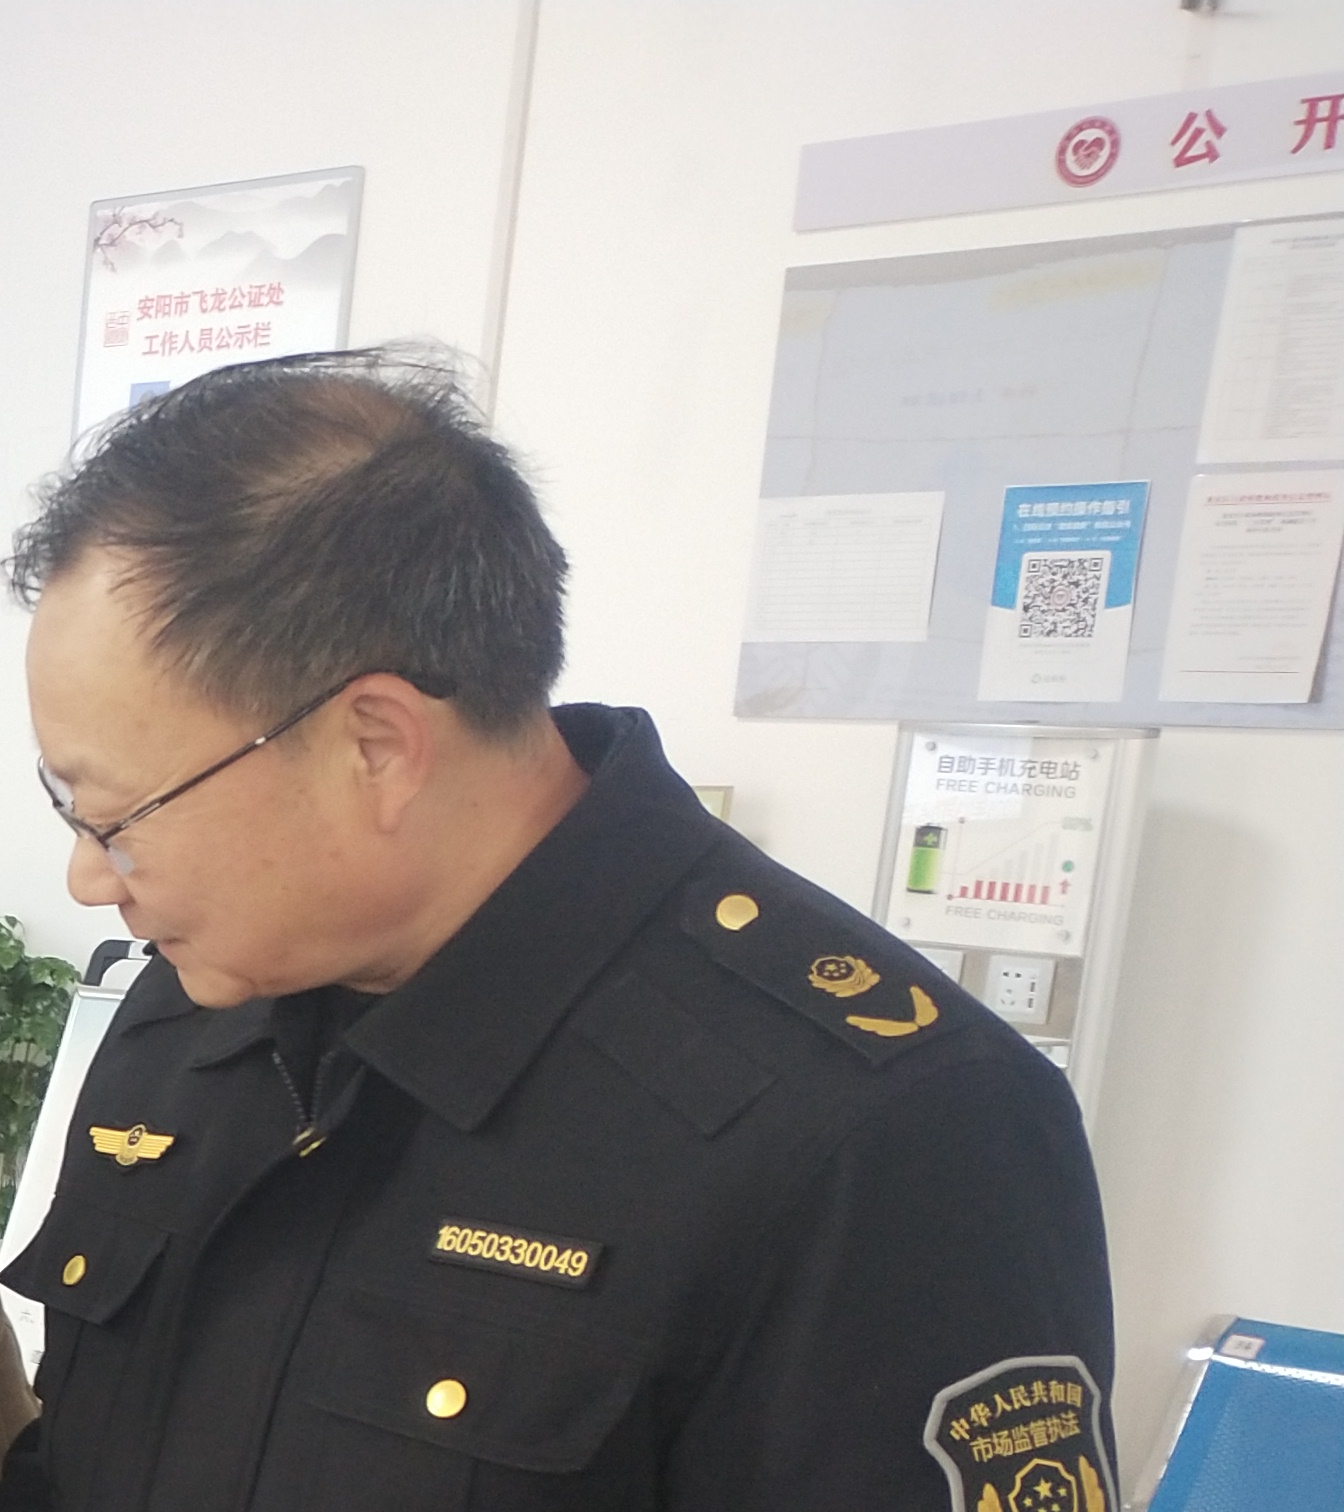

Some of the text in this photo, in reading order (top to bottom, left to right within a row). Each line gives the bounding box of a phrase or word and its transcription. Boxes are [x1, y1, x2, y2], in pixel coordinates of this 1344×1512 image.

[136, 282, 285, 321] 安阳市飞龙公证处
[141, 321, 272, 356] 工作人员公示栏
[937, 755, 1081, 781] 自助手机充电站
[936, 778, 1077, 799] FREE CHARGING
[945, 905, 984, 919] FREE
[436, 1225, 589, 1277] 16050330049
[949, 1380, 1083, 1441] 中华人民共和国
[969, 1409, 1081, 1463] 市场监管执法
